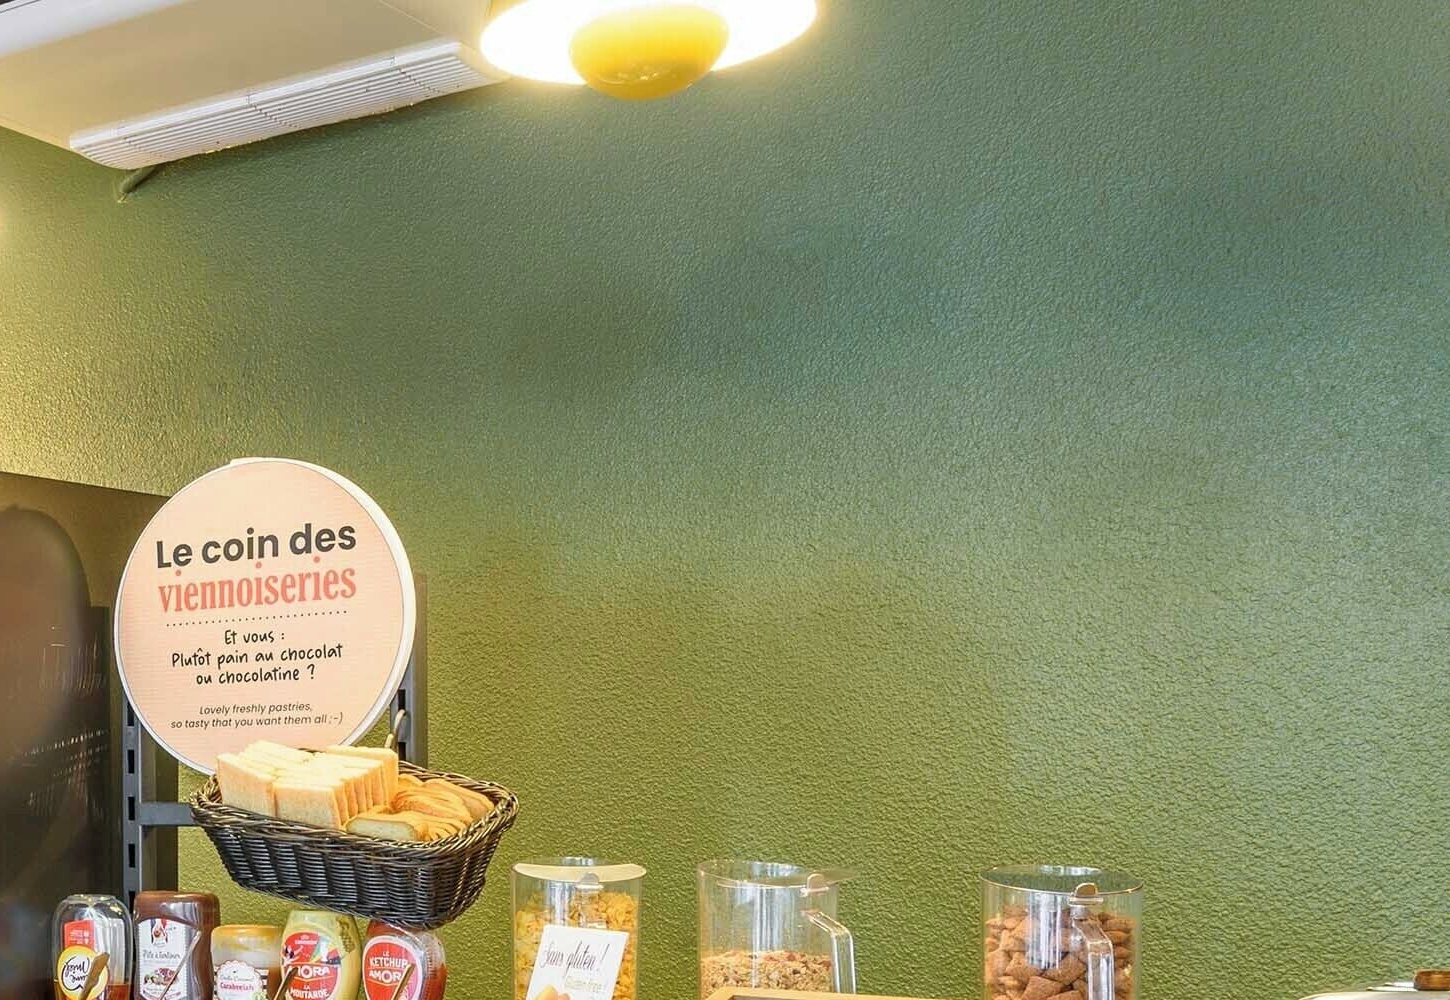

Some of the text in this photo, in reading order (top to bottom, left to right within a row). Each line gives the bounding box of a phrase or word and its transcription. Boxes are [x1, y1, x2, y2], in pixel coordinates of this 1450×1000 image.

[156, 523, 356, 568] Le coin des
[158, 556, 356, 614] viennoiseries
[224, 629, 238, 645] Et
[243, 630, 274, 644] vous
[171, 643, 343, 670] Plutôt pain au chocolat
[196, 663, 315, 685] ou chocolatine ?
[199, 701, 313, 717] Lovely freshly pastries,
[170, 720, 182, 729] so
[185, 718, 210, 730] tasty
[211, 717, 233, 728] that
[234, 718, 254, 729] you
[255, 716, 281, 726] want
[283, 714, 312, 725] them
[314, 713, 326, 724] all
[369, 958, 409, 969] KETCHUP
[540, 941, 564, 969] Sans
[290, 988, 330, 1000] MOUTARDE
